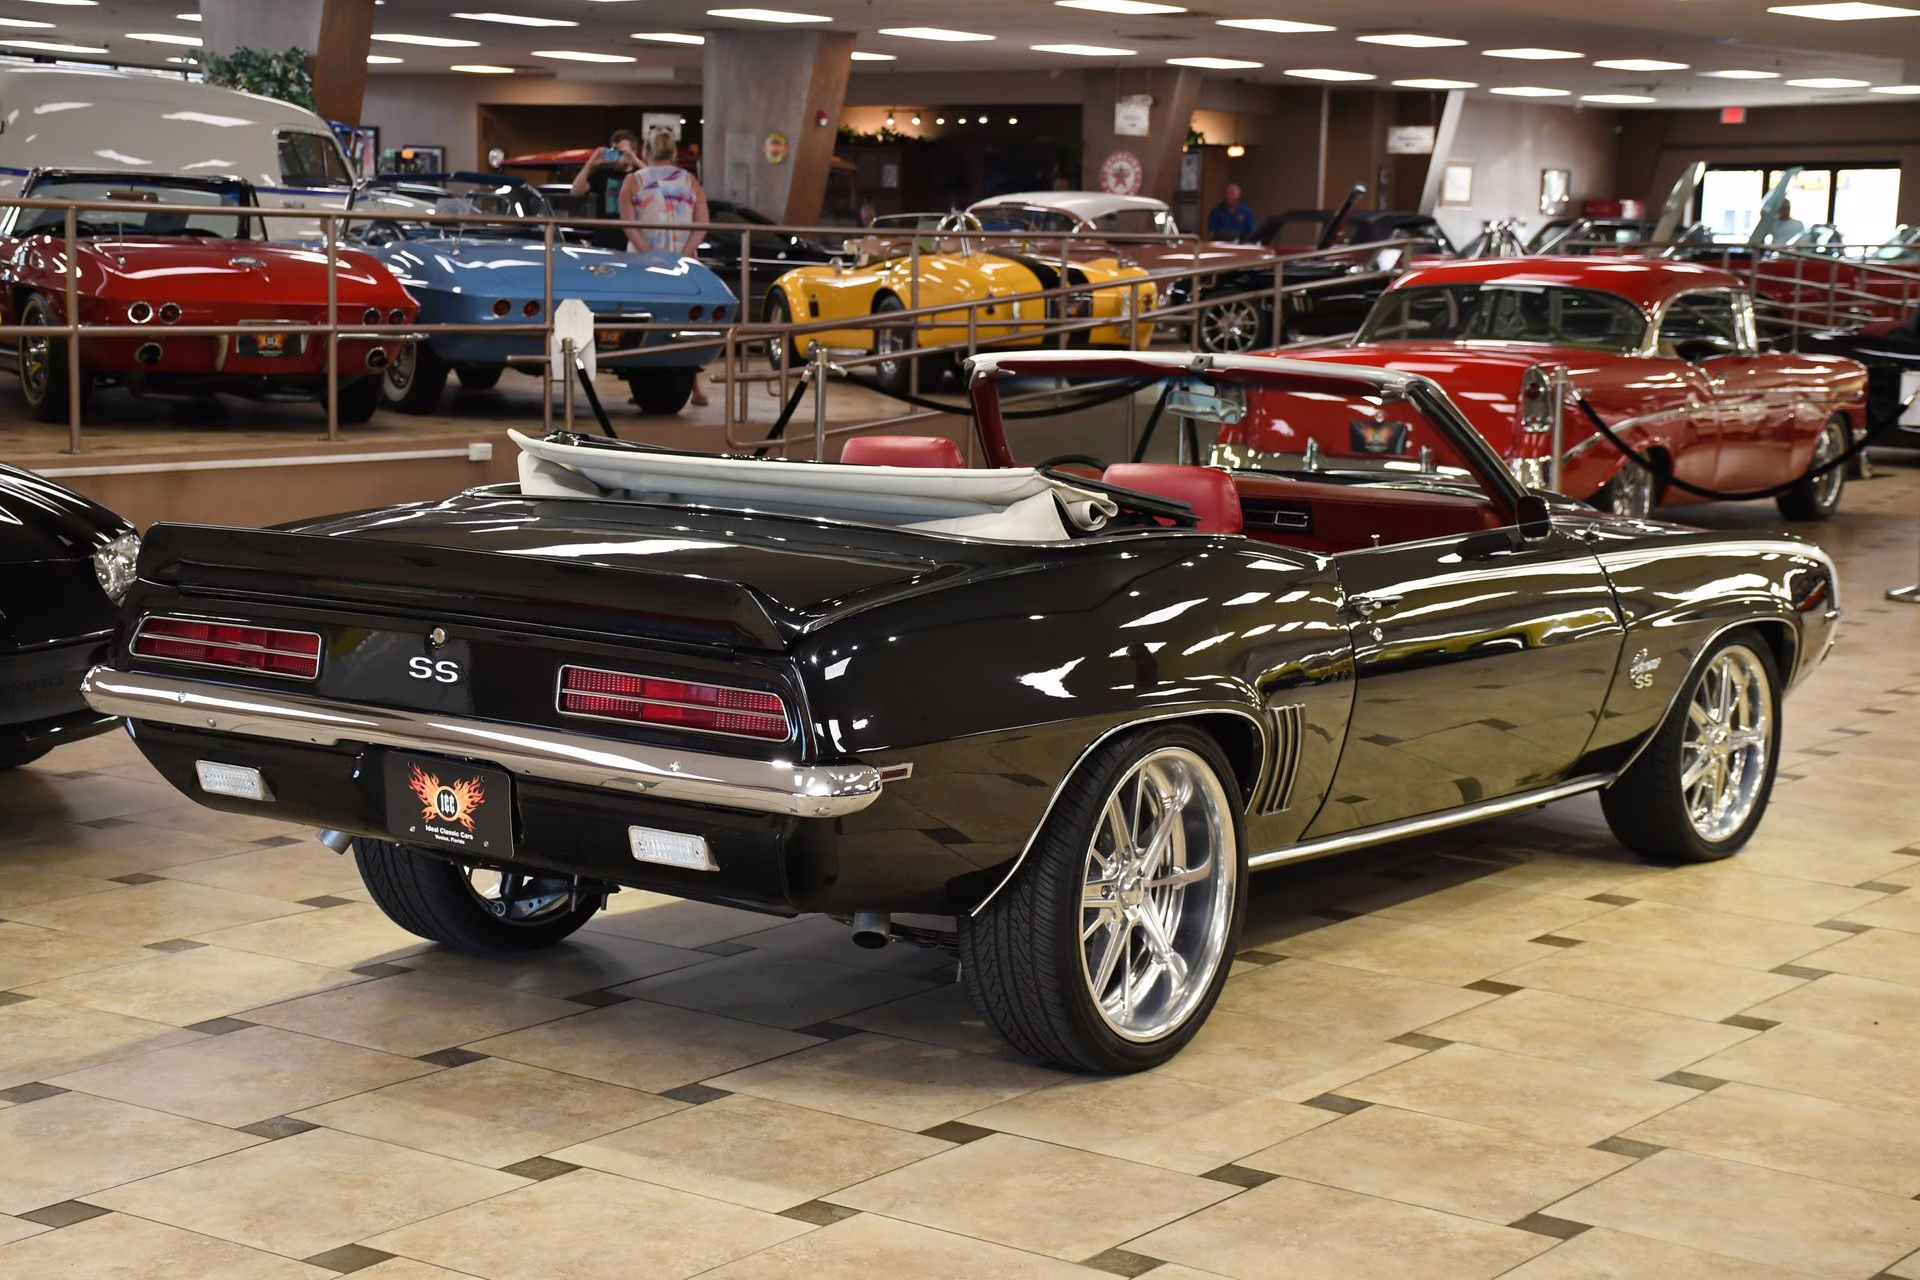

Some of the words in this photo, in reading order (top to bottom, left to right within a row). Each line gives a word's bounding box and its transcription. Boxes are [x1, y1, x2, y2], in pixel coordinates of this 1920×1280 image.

[409, 656, 459, 683] SS
[1633, 673, 1653, 689] SS
[440, 793, 455, 815] ICC
[425, 824, 439, 833] Ideal
[440, 827, 460, 837] Classic
[460, 831, 474, 840] Cars
[450, 837, 465, 845] Florida
